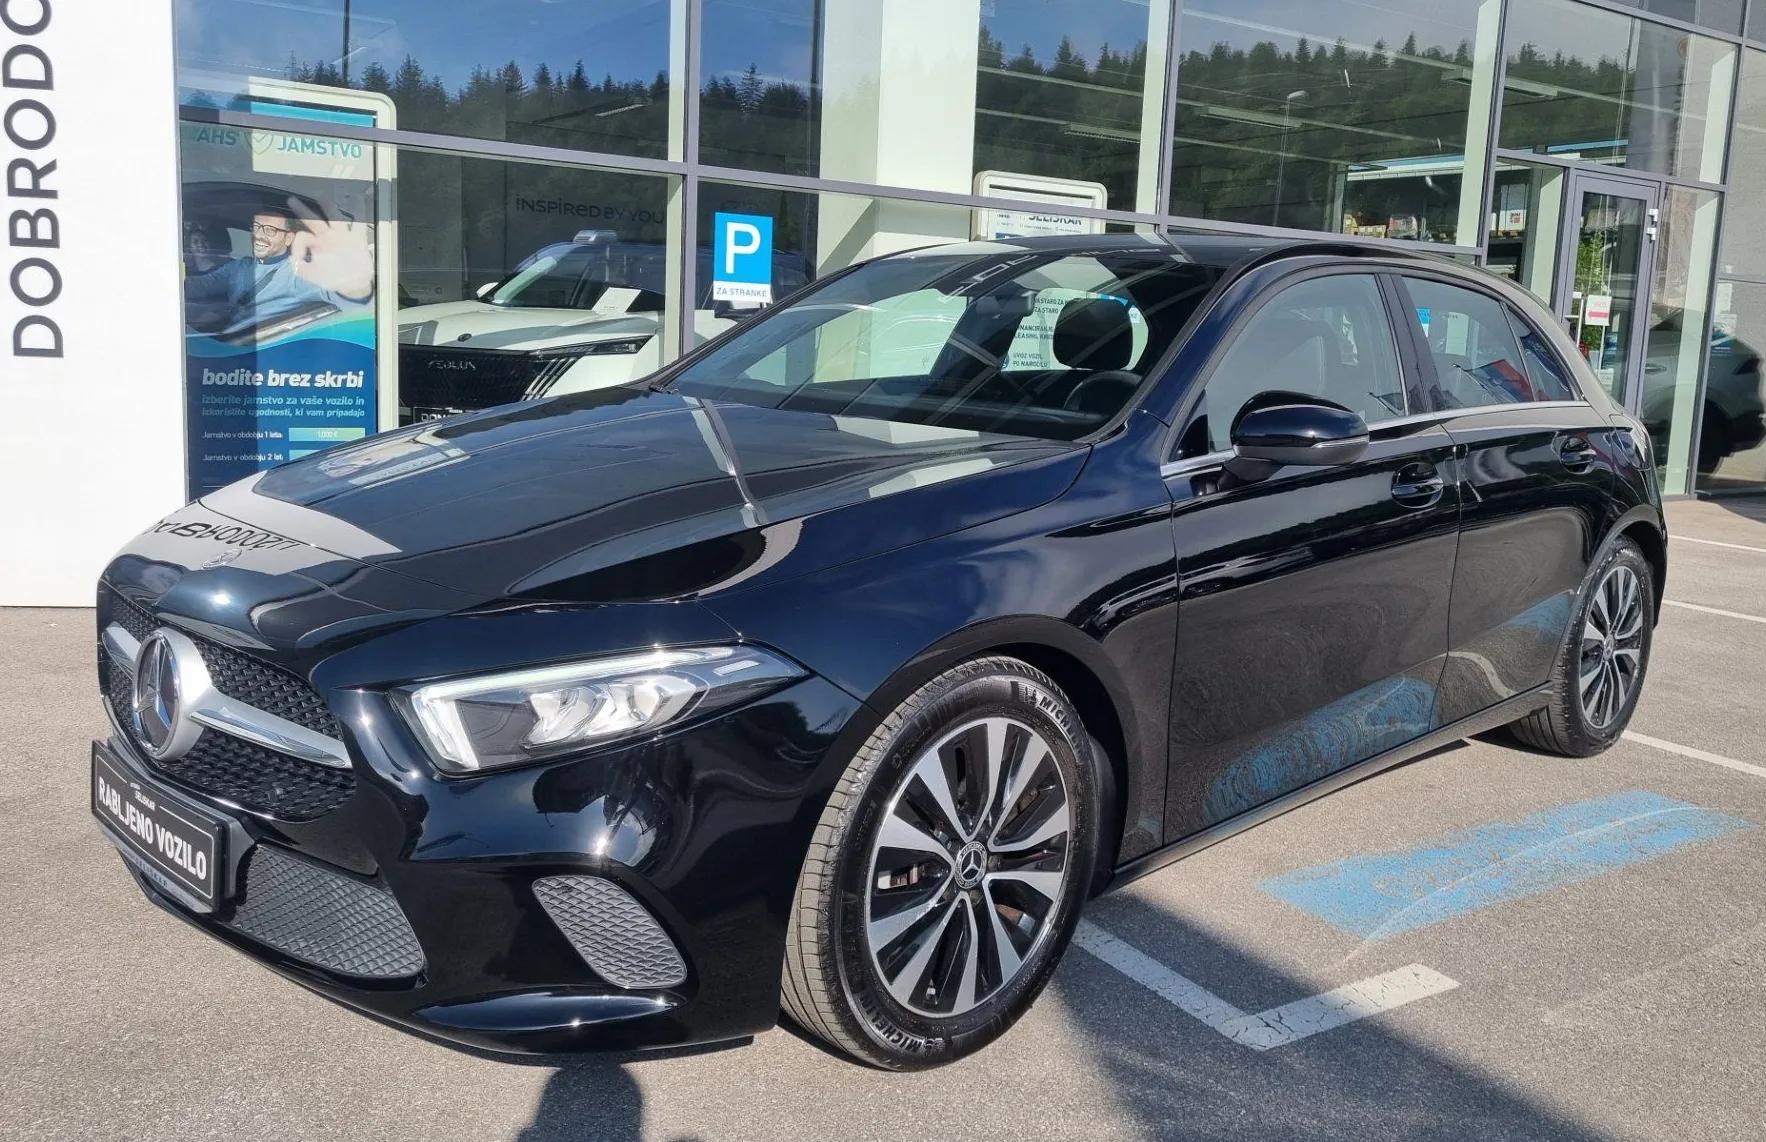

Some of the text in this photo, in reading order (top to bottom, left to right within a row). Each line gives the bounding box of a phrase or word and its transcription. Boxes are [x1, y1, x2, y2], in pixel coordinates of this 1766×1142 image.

[196, 127, 362, 159] AHS JAMSTVO
[604, 206, 627, 220] BY
[629, 209, 665, 224] YOU
[725, 221, 761, 274] P
[717, 287, 767, 297] ZA STRANKE
[202, 368, 364, 388] bodite brez skrbi
[202, 395, 242, 404] izberite
[243, 395, 284, 406] jamstvo
[300, 395, 323, 405] vaše
[325, 396, 354, 406] vozilo
[355, 396, 365, 406] in
[247, 408, 293, 418] ugodnosti,
[295, 408, 304, 417] ki
[326, 409, 365, 419] pripadajo
[202, 431, 231, 439] Jamstvo
[99, 776, 207, 881] RABLJENO VOZILO
